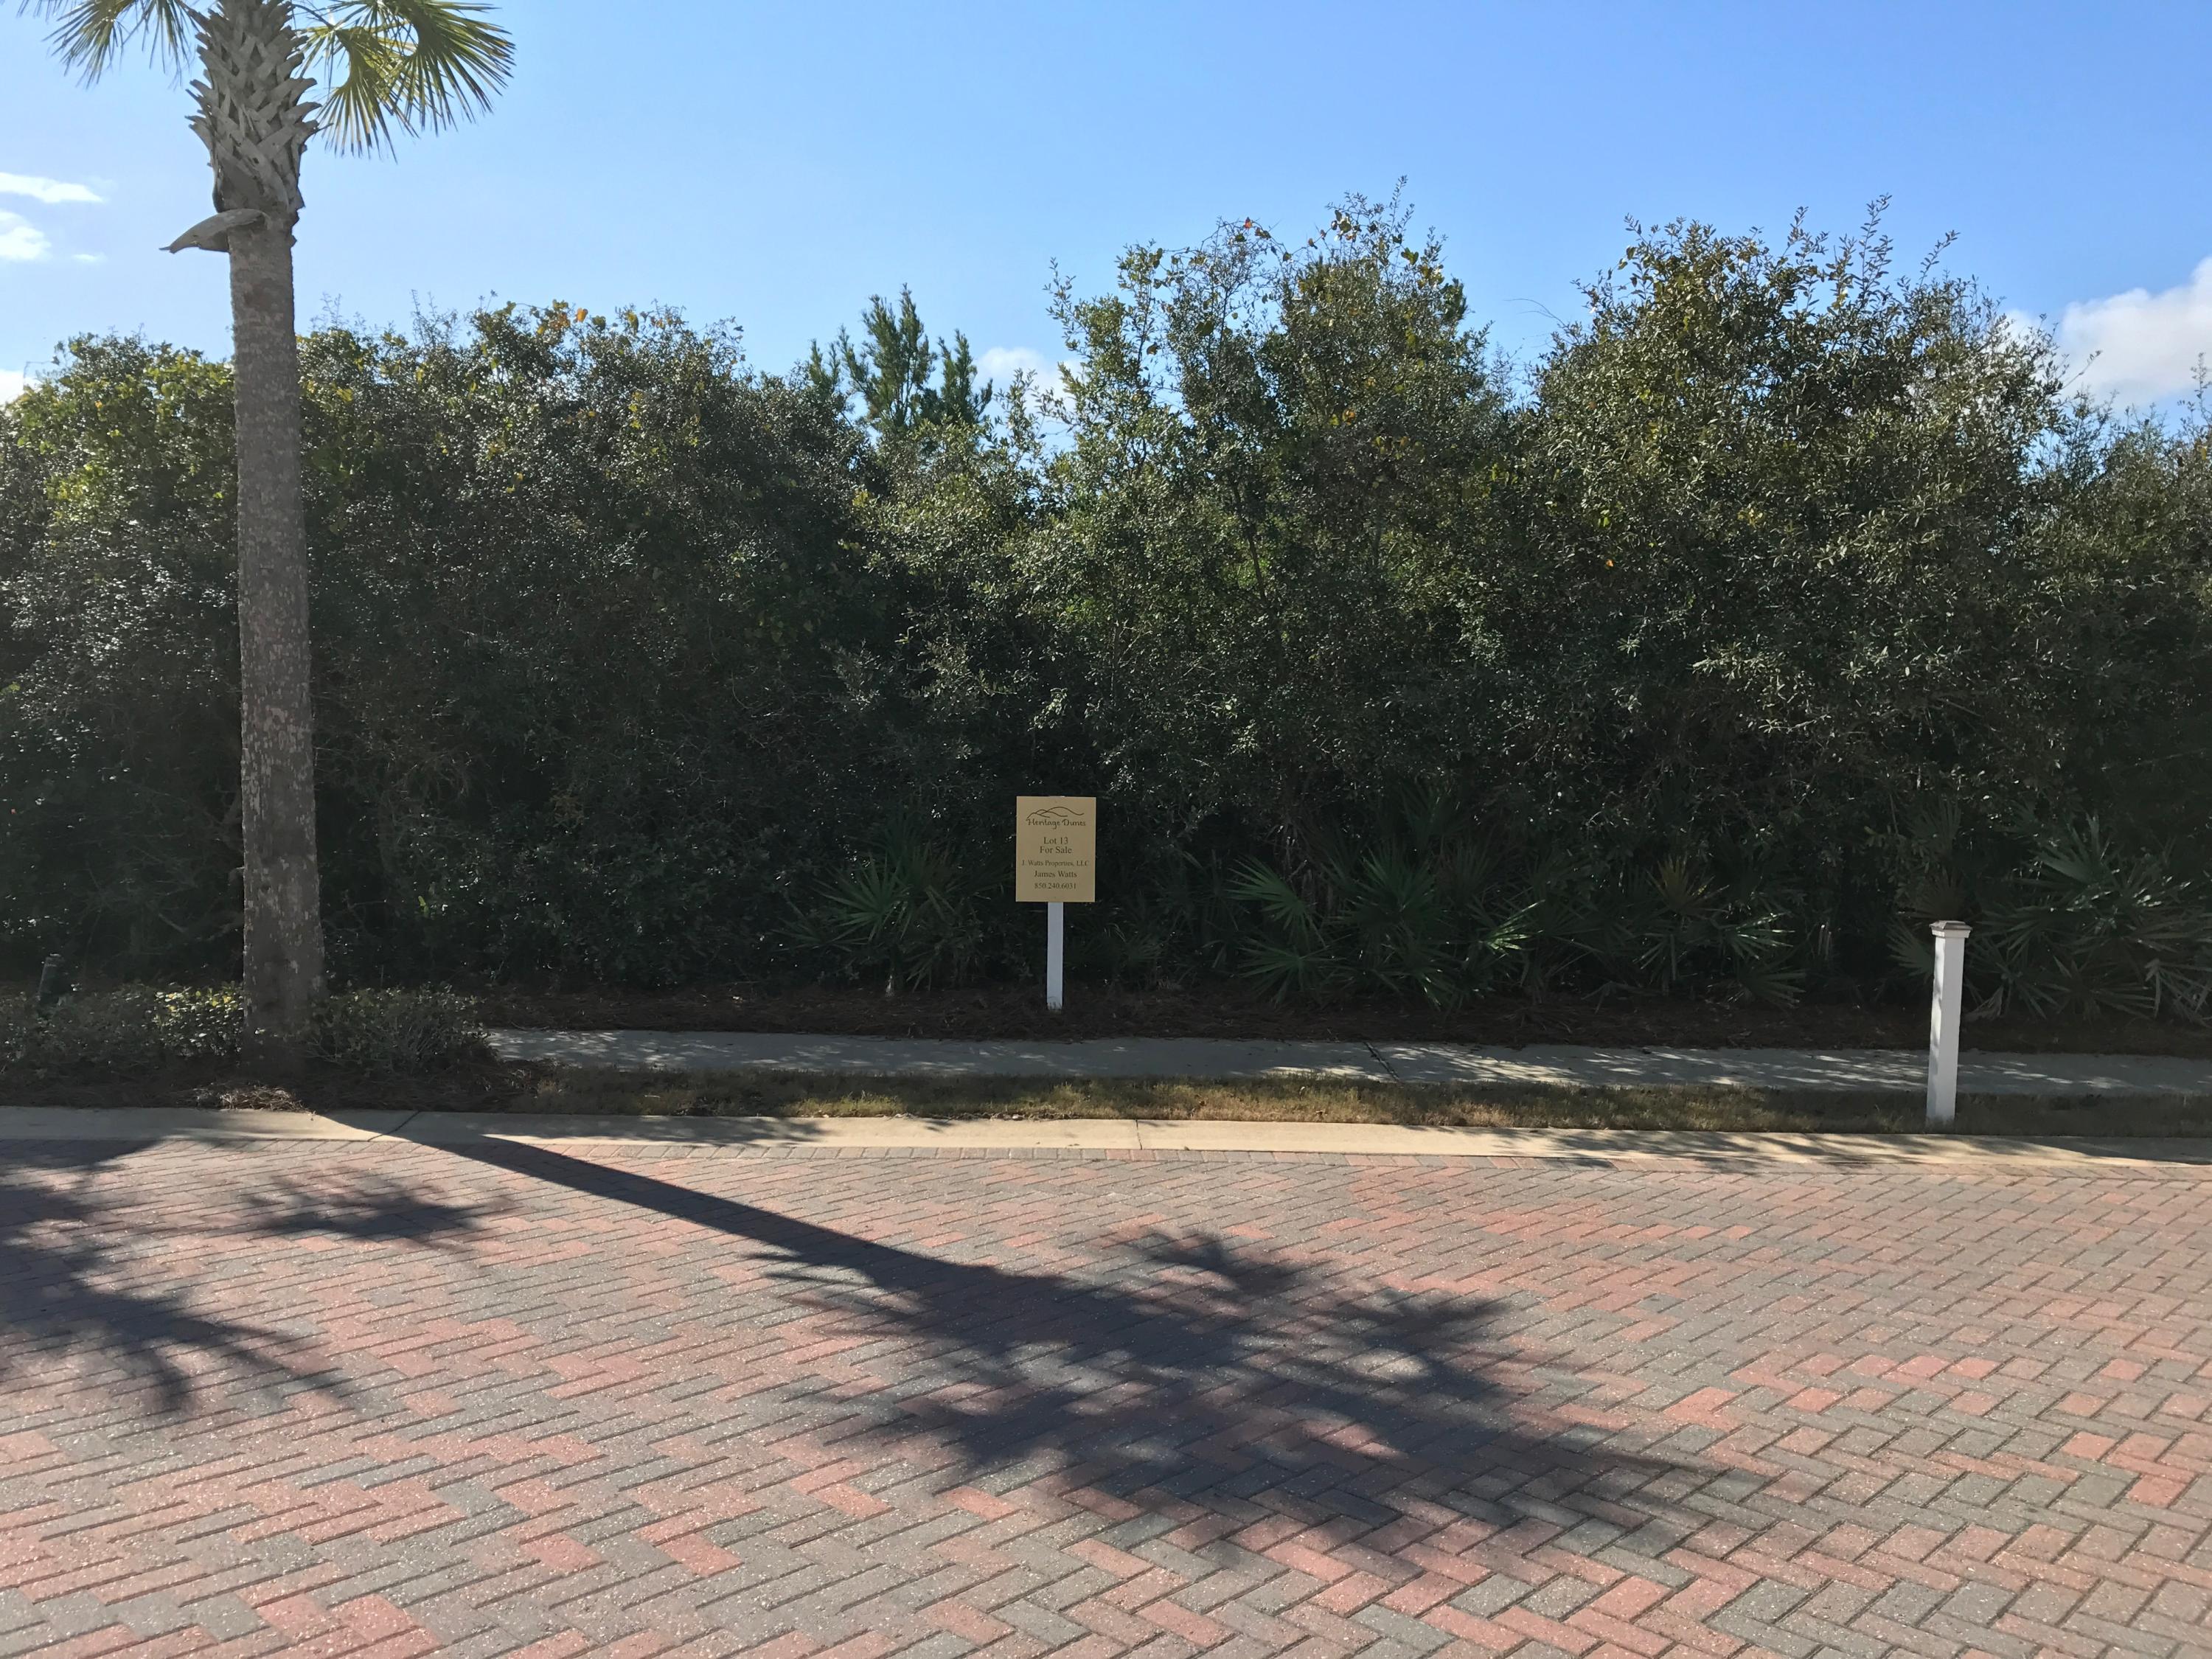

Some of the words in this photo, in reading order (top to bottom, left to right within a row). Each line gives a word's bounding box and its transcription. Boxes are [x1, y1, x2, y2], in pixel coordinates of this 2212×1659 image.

[1026, 818, 1060, 830] Heritage
[1062, 818, 1086, 827] Dunes
[1040, 846, 1053, 854] For
[1055, 846, 1072, 854] Sale
[1045, 860, 1074, 868] Properties,
